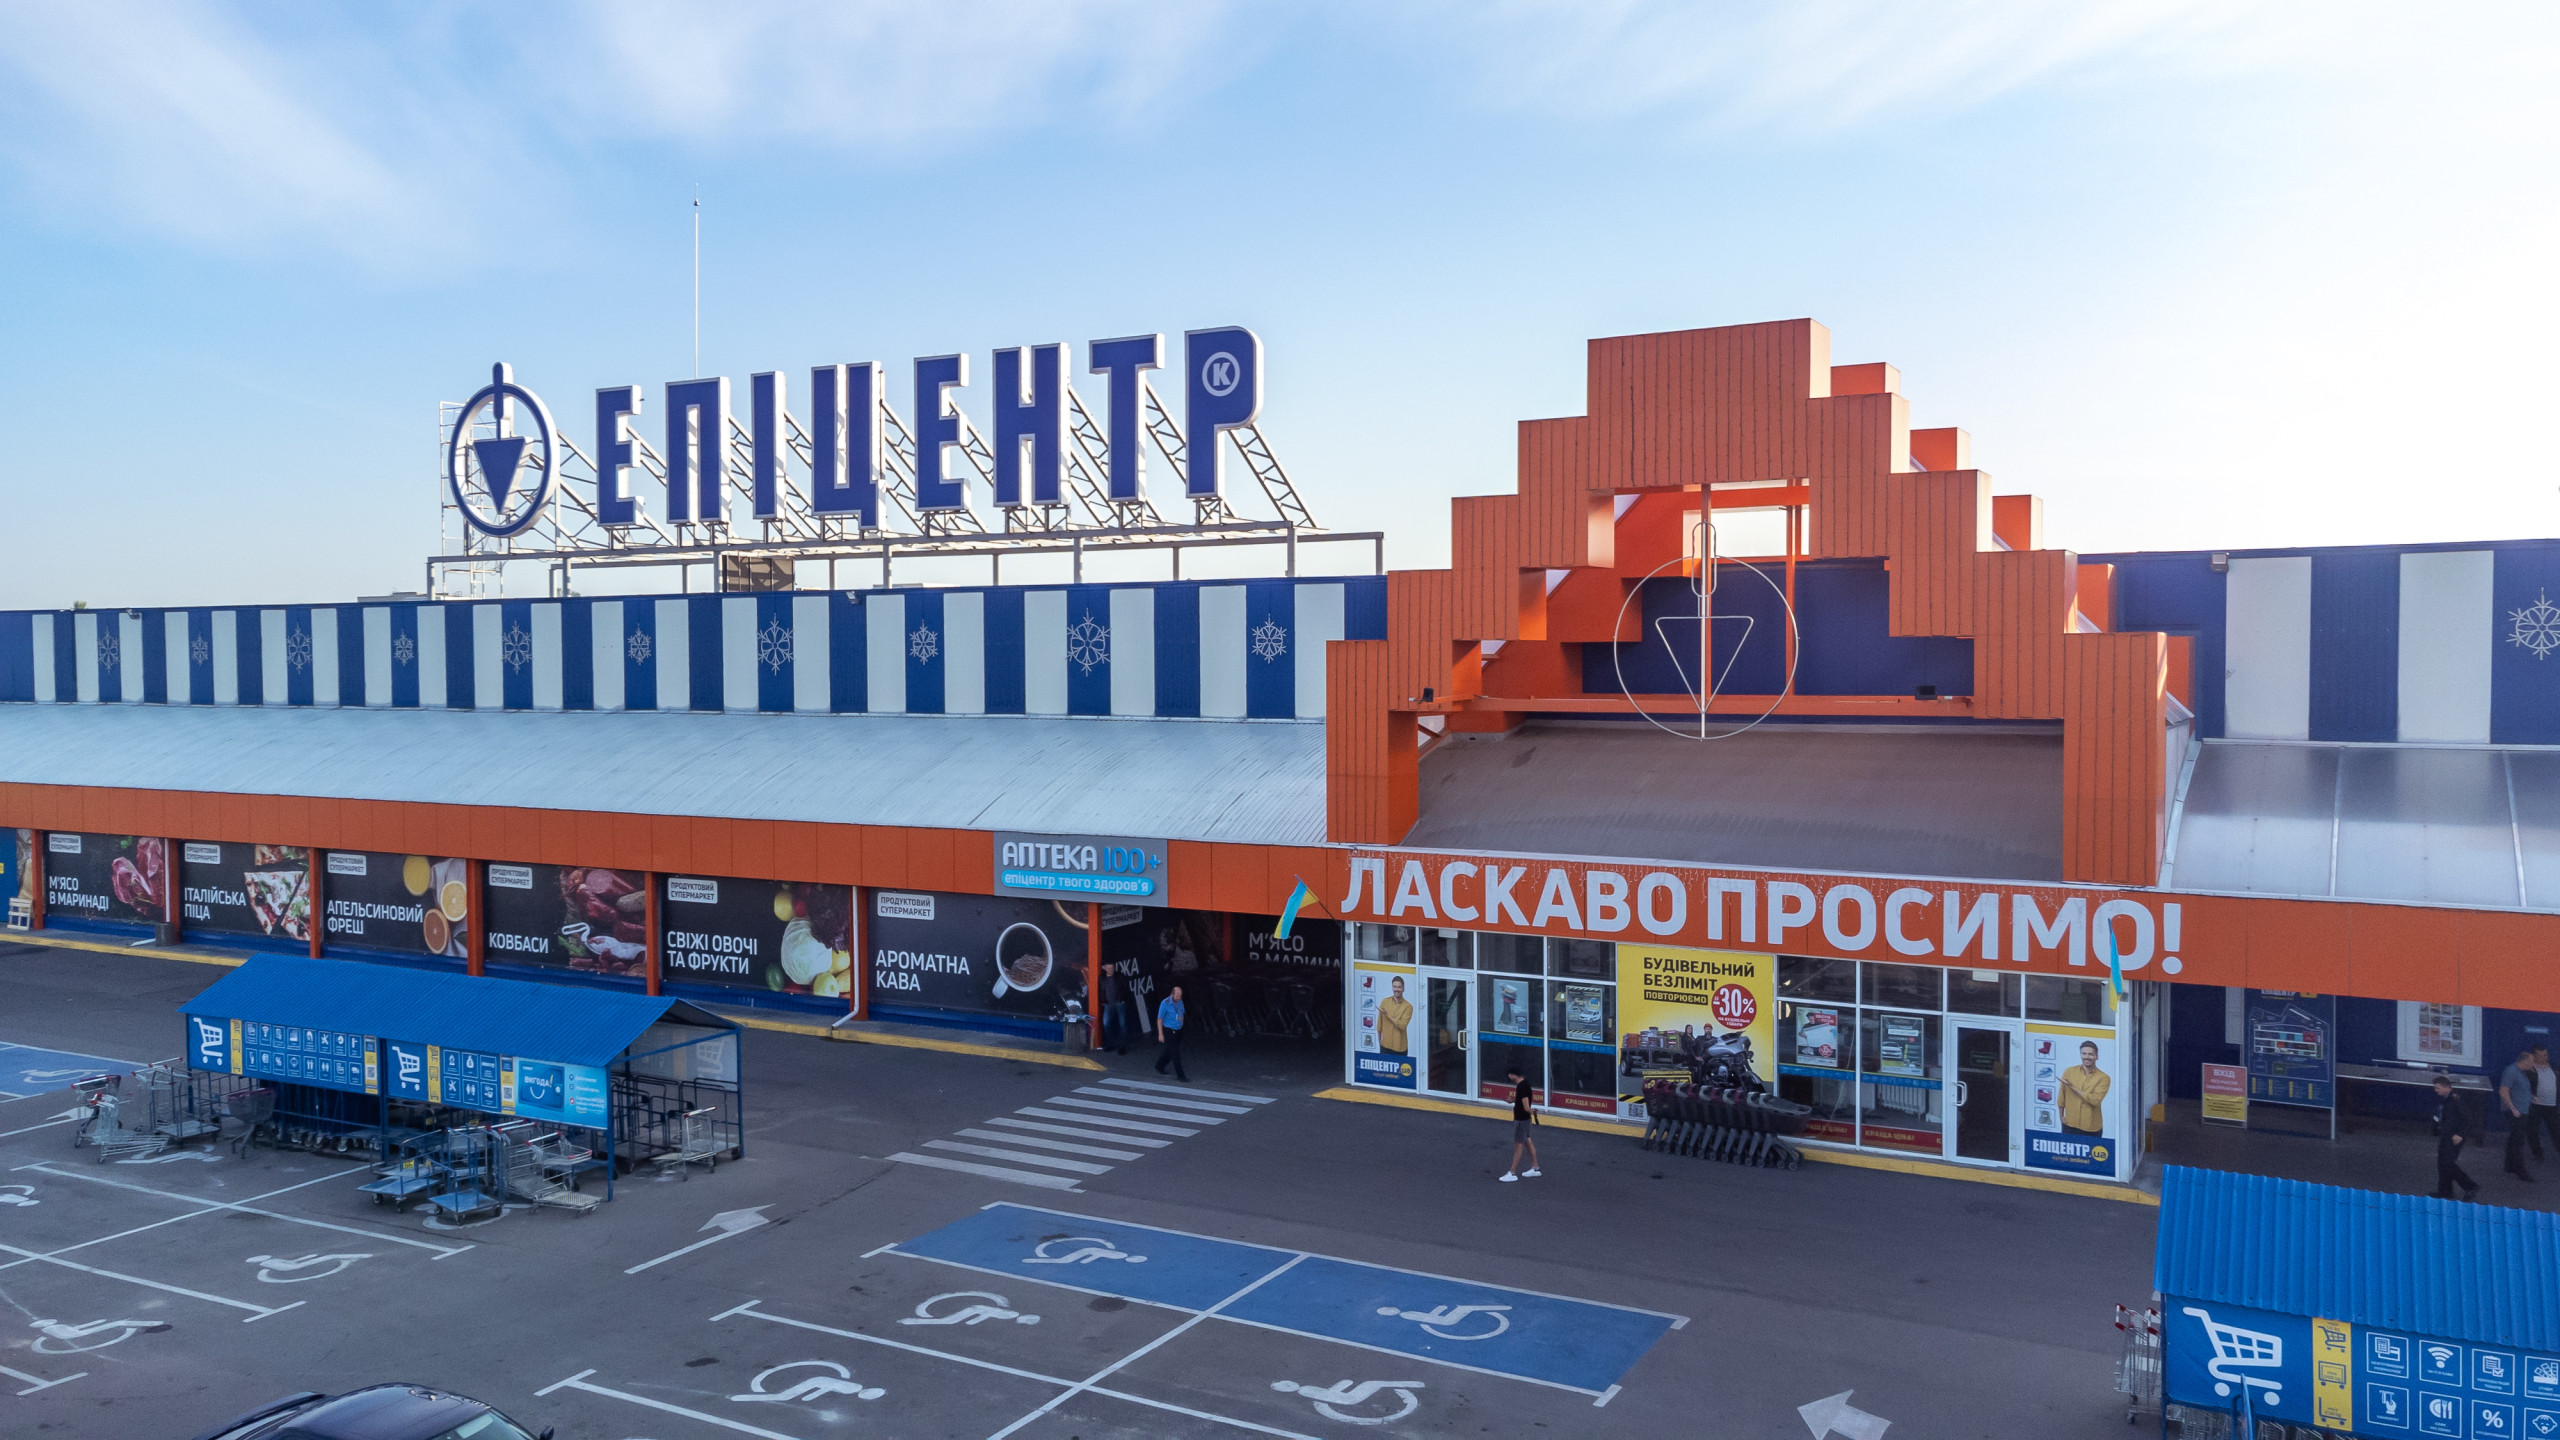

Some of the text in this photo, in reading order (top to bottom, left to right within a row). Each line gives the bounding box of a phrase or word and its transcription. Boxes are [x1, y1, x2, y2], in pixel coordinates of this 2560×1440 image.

[596, 325, 1264, 531] ЕПІЦЕНТР
[1002, 842, 1098, 871] АПТЕКА
[49, 876, 79, 891] М'ЯСО
[670, 882, 715, 891] ПРОДУКТОВИЙ
[1004, 872, 1149, 893] епіцентр твого здоров'я
[49, 893, 109, 911] В МАРИНАДІ
[184, 886, 247, 906] ІТАЛІЙСЬКА
[670, 891, 715, 901] СУПЕРМАРКЕТ
[880, 896, 931, 907] ПРОДУКТОВИЙ
[184, 904, 211, 921] ПІЦА
[327, 900, 424, 923] АПЕЛЬСИНОВИЙ
[880, 906, 931, 917] СУПЕРМАРКЕТ
[1340, 857, 2183, 975] ЛАСКАВО ПРОСИМО!
[327, 917, 364, 935] ФРЕШ
[489, 932, 549, 953] КОВБАСИ
[667, 931, 758, 955] СВІЖІ ОВОЧІ
[1249, 931, 1304, 952] М'ЯСО
[667, 950, 749, 975] ТА ФРУКТИ
[875, 949, 970, 975] АРОМАТНА
[1115, 957, 1140, 976] ІЖА
[1643, 957, 1755, 978] БУДІВЕЛЬНИЙ
[876, 970, 921, 991] КАВА
[1129, 974, 1154, 996] ЧКА
[1643, 973, 1718, 991] БЕЗЛІМІТ
[1645, 991, 1707, 1004] ПОВТОРЮЄМО
[1713, 987, 1755, 1018] -30%
